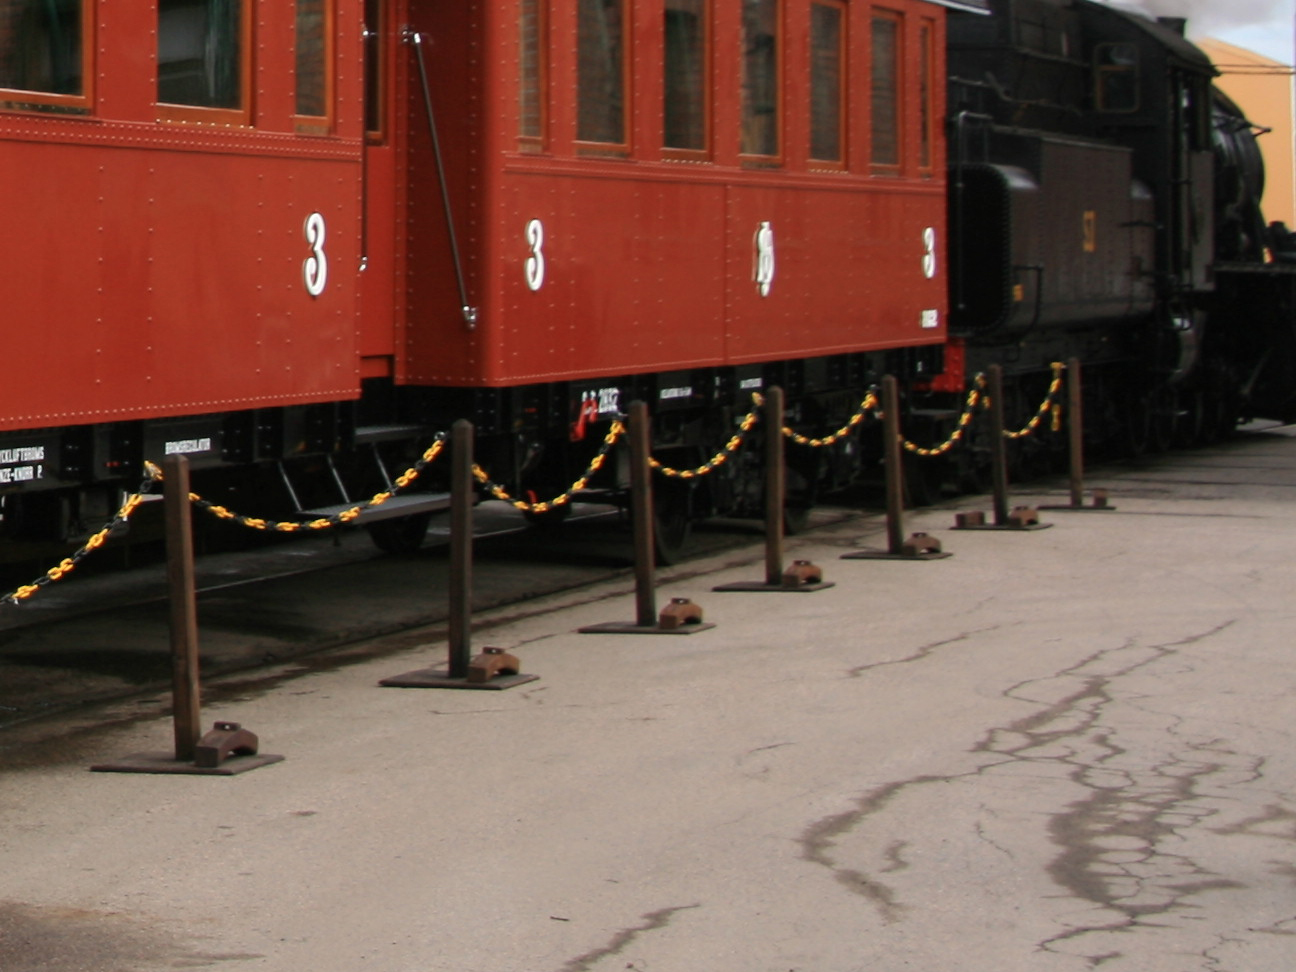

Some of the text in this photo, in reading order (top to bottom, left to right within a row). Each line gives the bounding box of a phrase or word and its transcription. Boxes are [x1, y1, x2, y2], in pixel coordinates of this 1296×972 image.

[304, 212, 328, 296] 3
[525, 218, 545, 291] 3
[922, 227, 936, 278] 3
